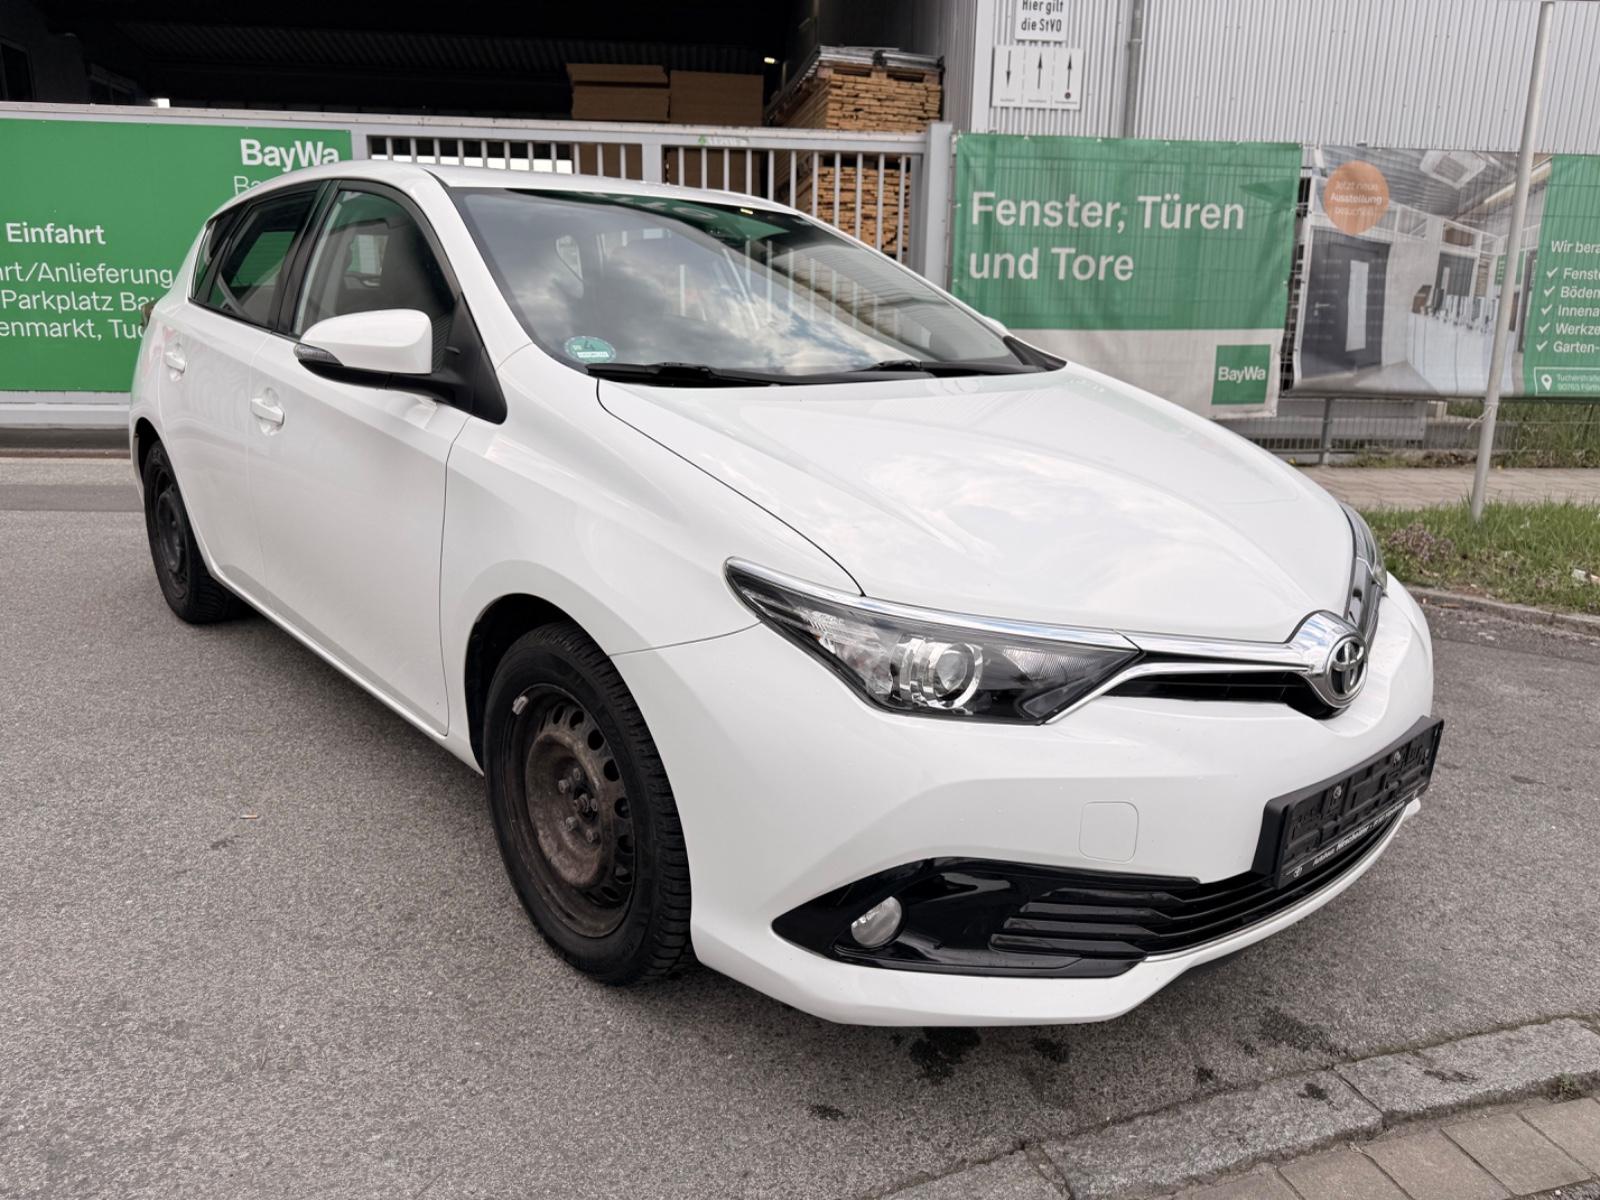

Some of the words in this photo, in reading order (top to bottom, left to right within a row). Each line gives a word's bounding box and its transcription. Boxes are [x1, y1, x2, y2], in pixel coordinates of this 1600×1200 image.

[1022, 0, 1043, 11] Hier
[1046, 0, 1063, 15] gilt
[1021, 17, 1037, 31] die
[1039, 18, 1062, 32] StVO
[240, 139, 339, 172] BayWa
[971, 192, 1125, 233] Fenster,
[1137, 193, 1244, 230] Türen
[6, 222, 106, 245] Einfahrt
[1551, 240, 1574, 253] Wir
[0, 262, 173, 288] rt/Anlieferung
[969, 248, 1039, 279] und
[1051, 248, 1134, 281] Tore
[1218, 366, 1266, 384] BayWa
